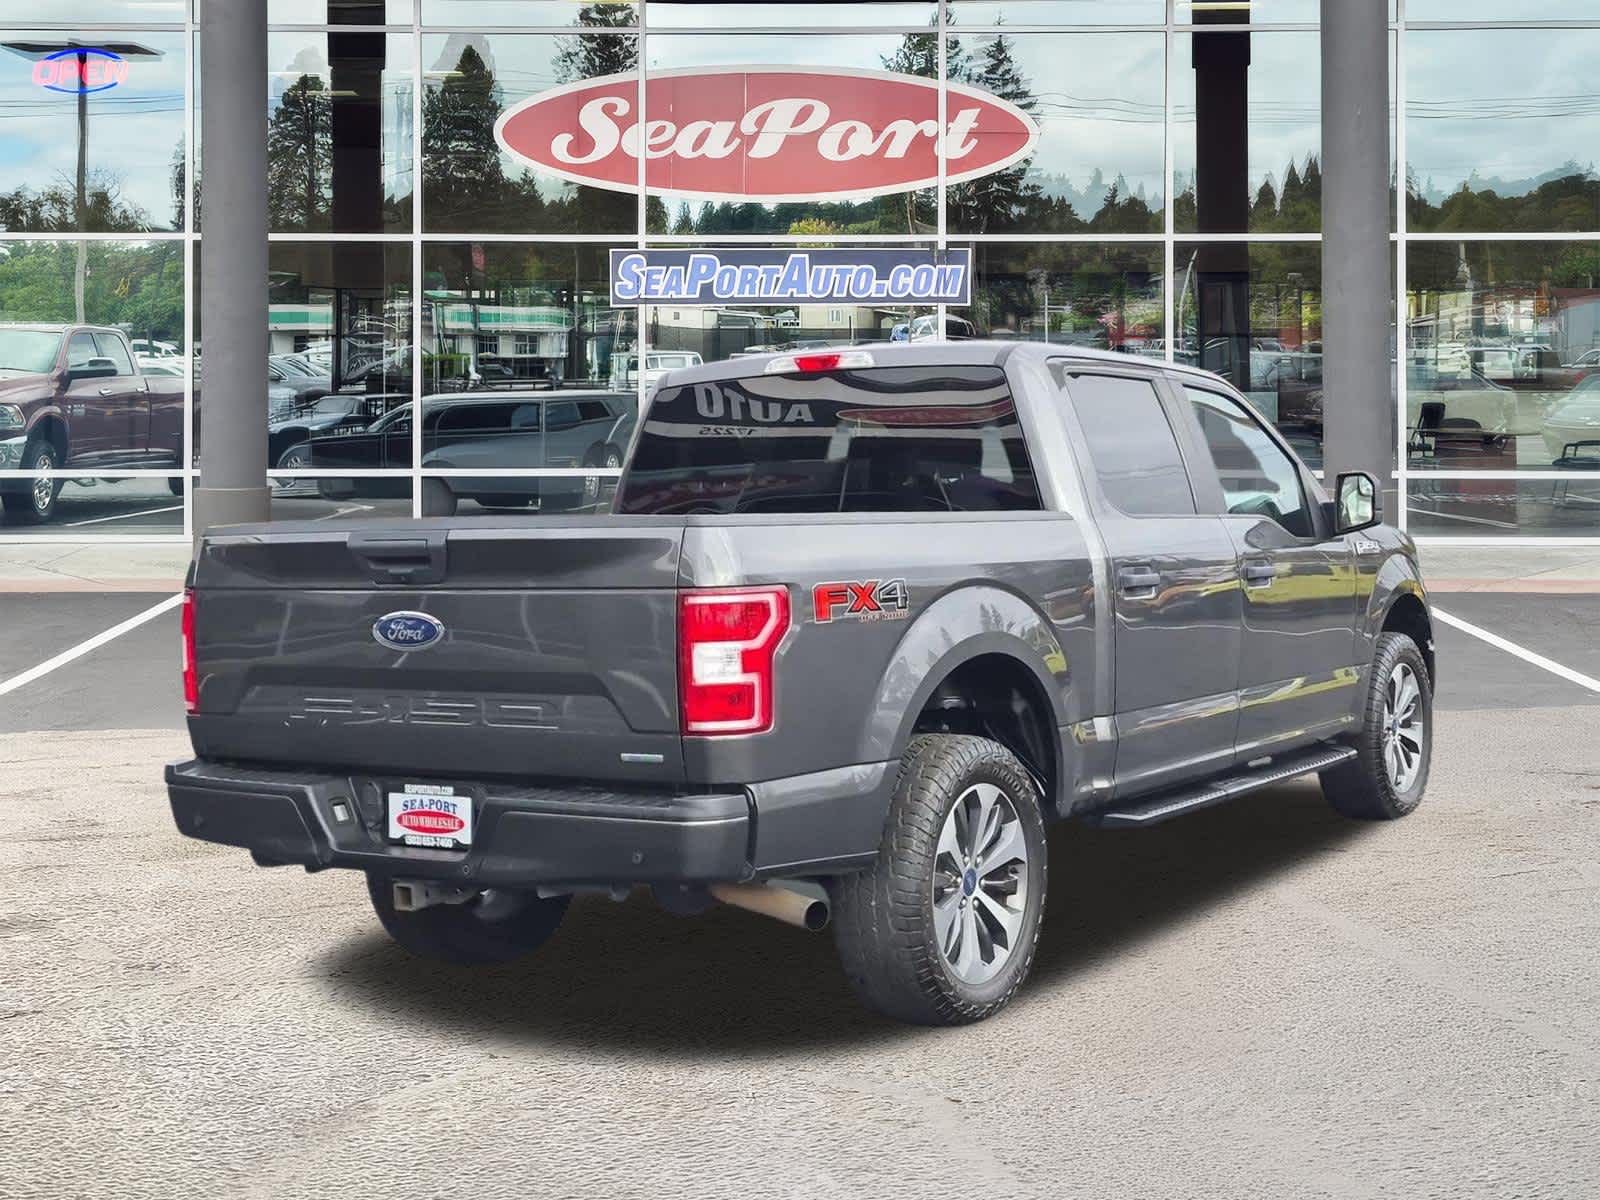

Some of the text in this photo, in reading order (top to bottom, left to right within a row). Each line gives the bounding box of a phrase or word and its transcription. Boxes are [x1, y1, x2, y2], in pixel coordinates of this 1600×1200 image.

[32, 59, 129, 86] OPEN
[550, 96, 981, 165] SeaPort
[812, 578, 909, 624] FX4
[387, 619, 425, 641] Ford
[402, 798, 458, 815] SEA-PORT
